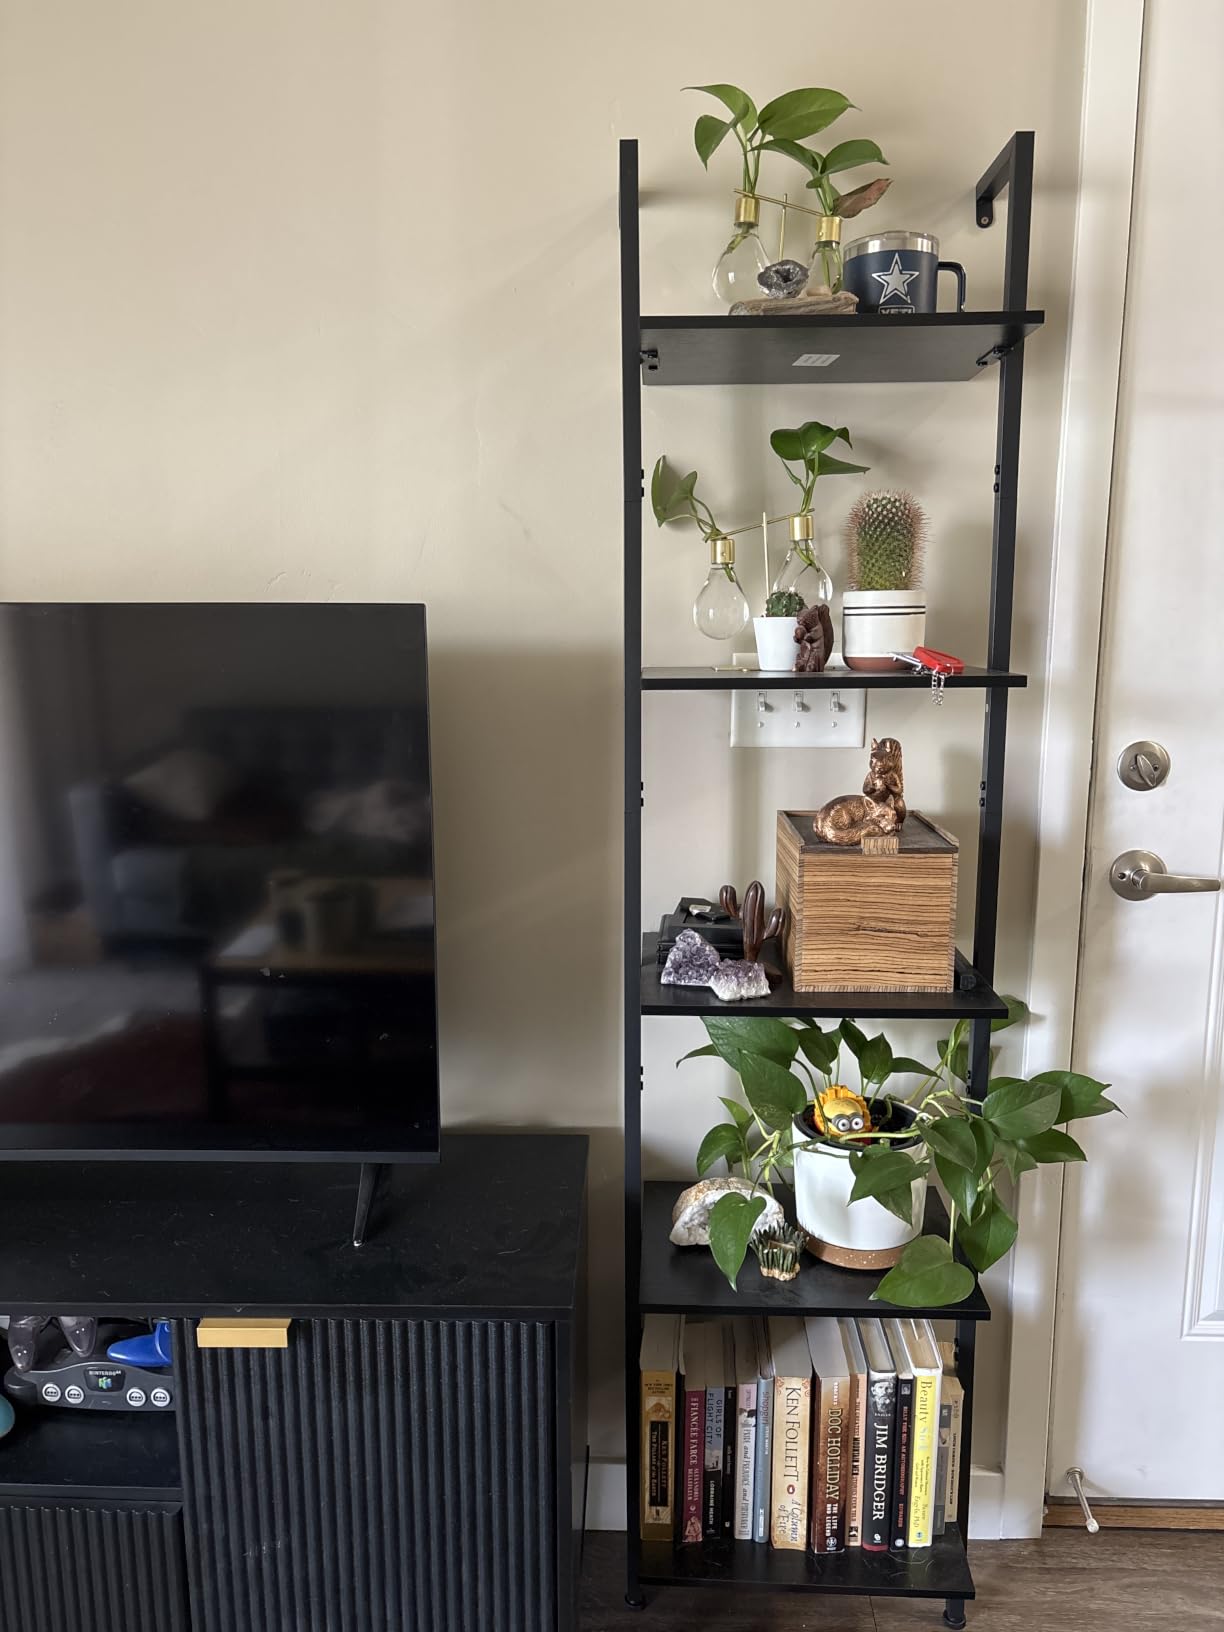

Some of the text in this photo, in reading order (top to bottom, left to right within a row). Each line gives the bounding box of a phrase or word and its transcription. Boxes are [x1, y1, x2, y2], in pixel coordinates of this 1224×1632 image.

[689, 1402, 701, 1438] FIANCÉE
[706, 1392, 715, 1445] FLIGHT CITY
[715, 1399, 723, 1439] GIRLS OF
[918, 1380, 933, 1424] Beauty
[688, 1439, 698, 1466] FARCE
[743, 1445, 751, 1459] and
[783, 1386, 802, 1482] KEN FOLLETT
[825, 1408, 842, 1500] DOC HOLLIDAY
[852, 1437, 861, 1463] MOUNTAIN
[660, 1440, 668, 1489] KEN FOLLETT
[872, 1422, 889, 1521] JIM BRIDGER
[899, 1453, 907, 1496] AUTOBIOGRAPHY
[777, 1504, 790, 1535] of Fire
[790, 1507, 803, 1542] Column
[897, 1503, 905, 1528] EDWARDS
